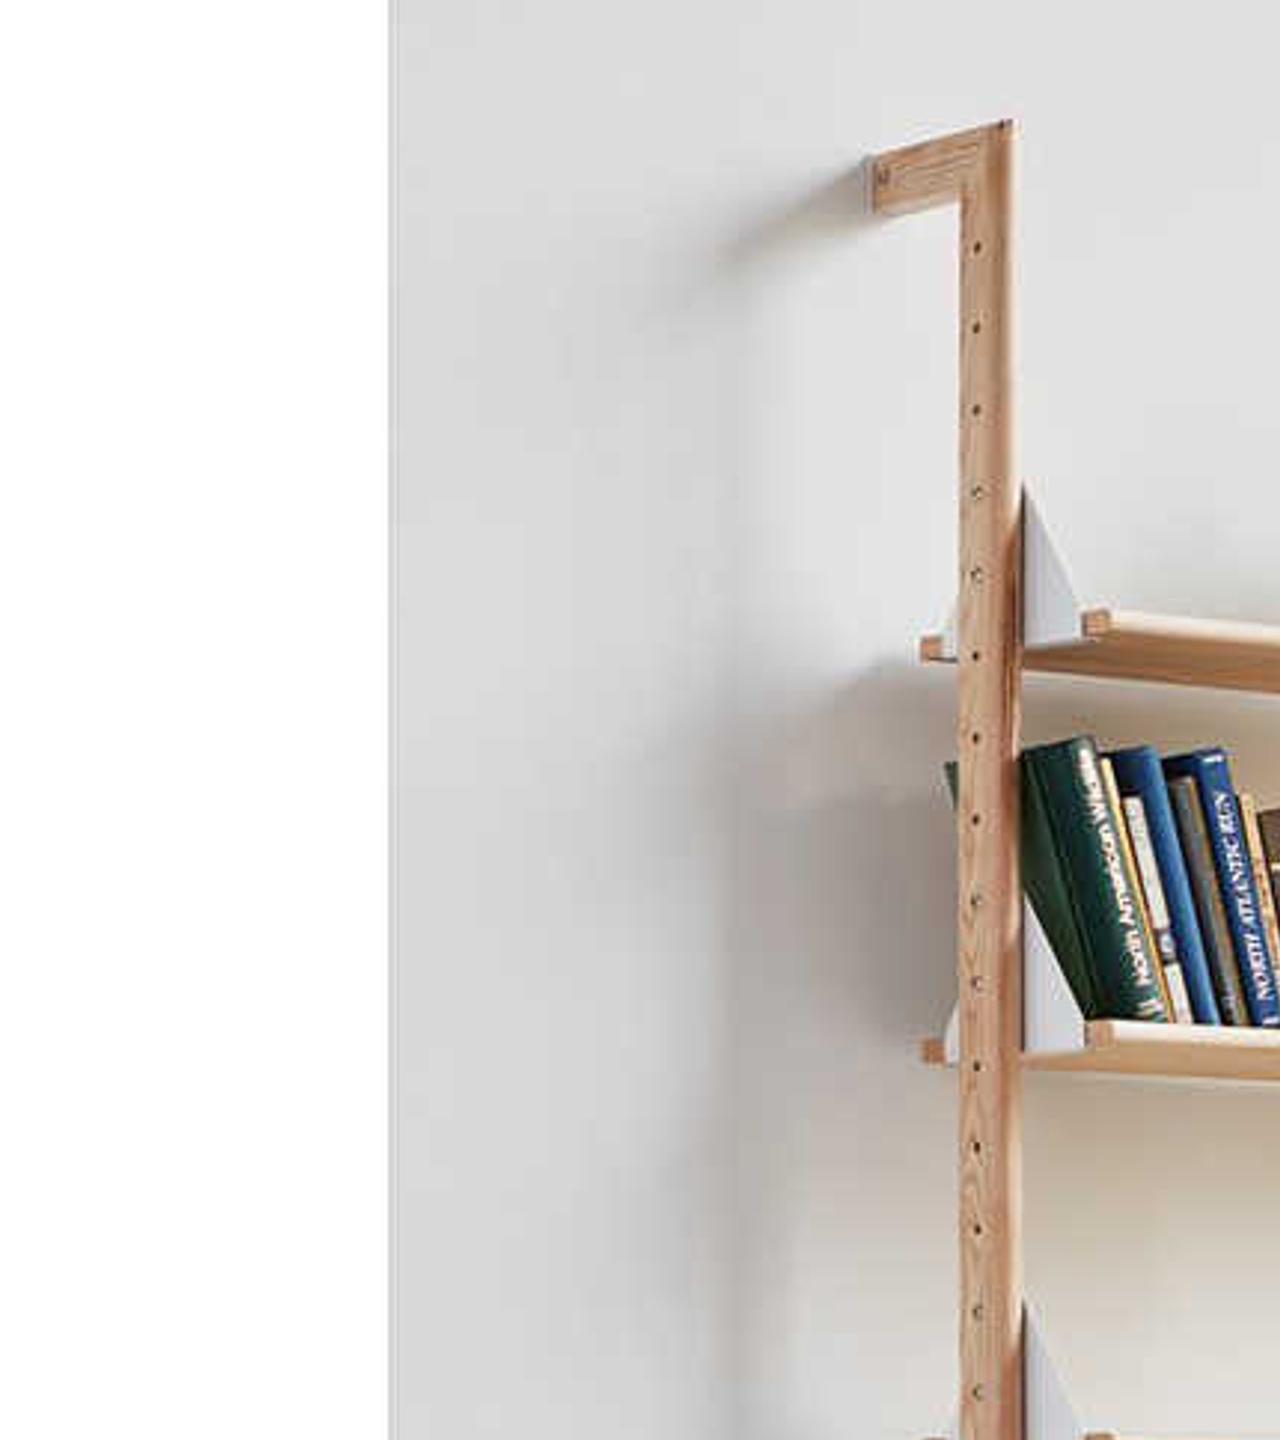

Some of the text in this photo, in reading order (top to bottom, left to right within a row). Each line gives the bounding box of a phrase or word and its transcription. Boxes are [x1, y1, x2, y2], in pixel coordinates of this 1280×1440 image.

[1097, 824, 1137, 926] American
[1224, 835, 1260, 929] ATLANTIC
[1125, 929, 1154, 987] North
[1246, 931, 1275, 1002] NORTH
